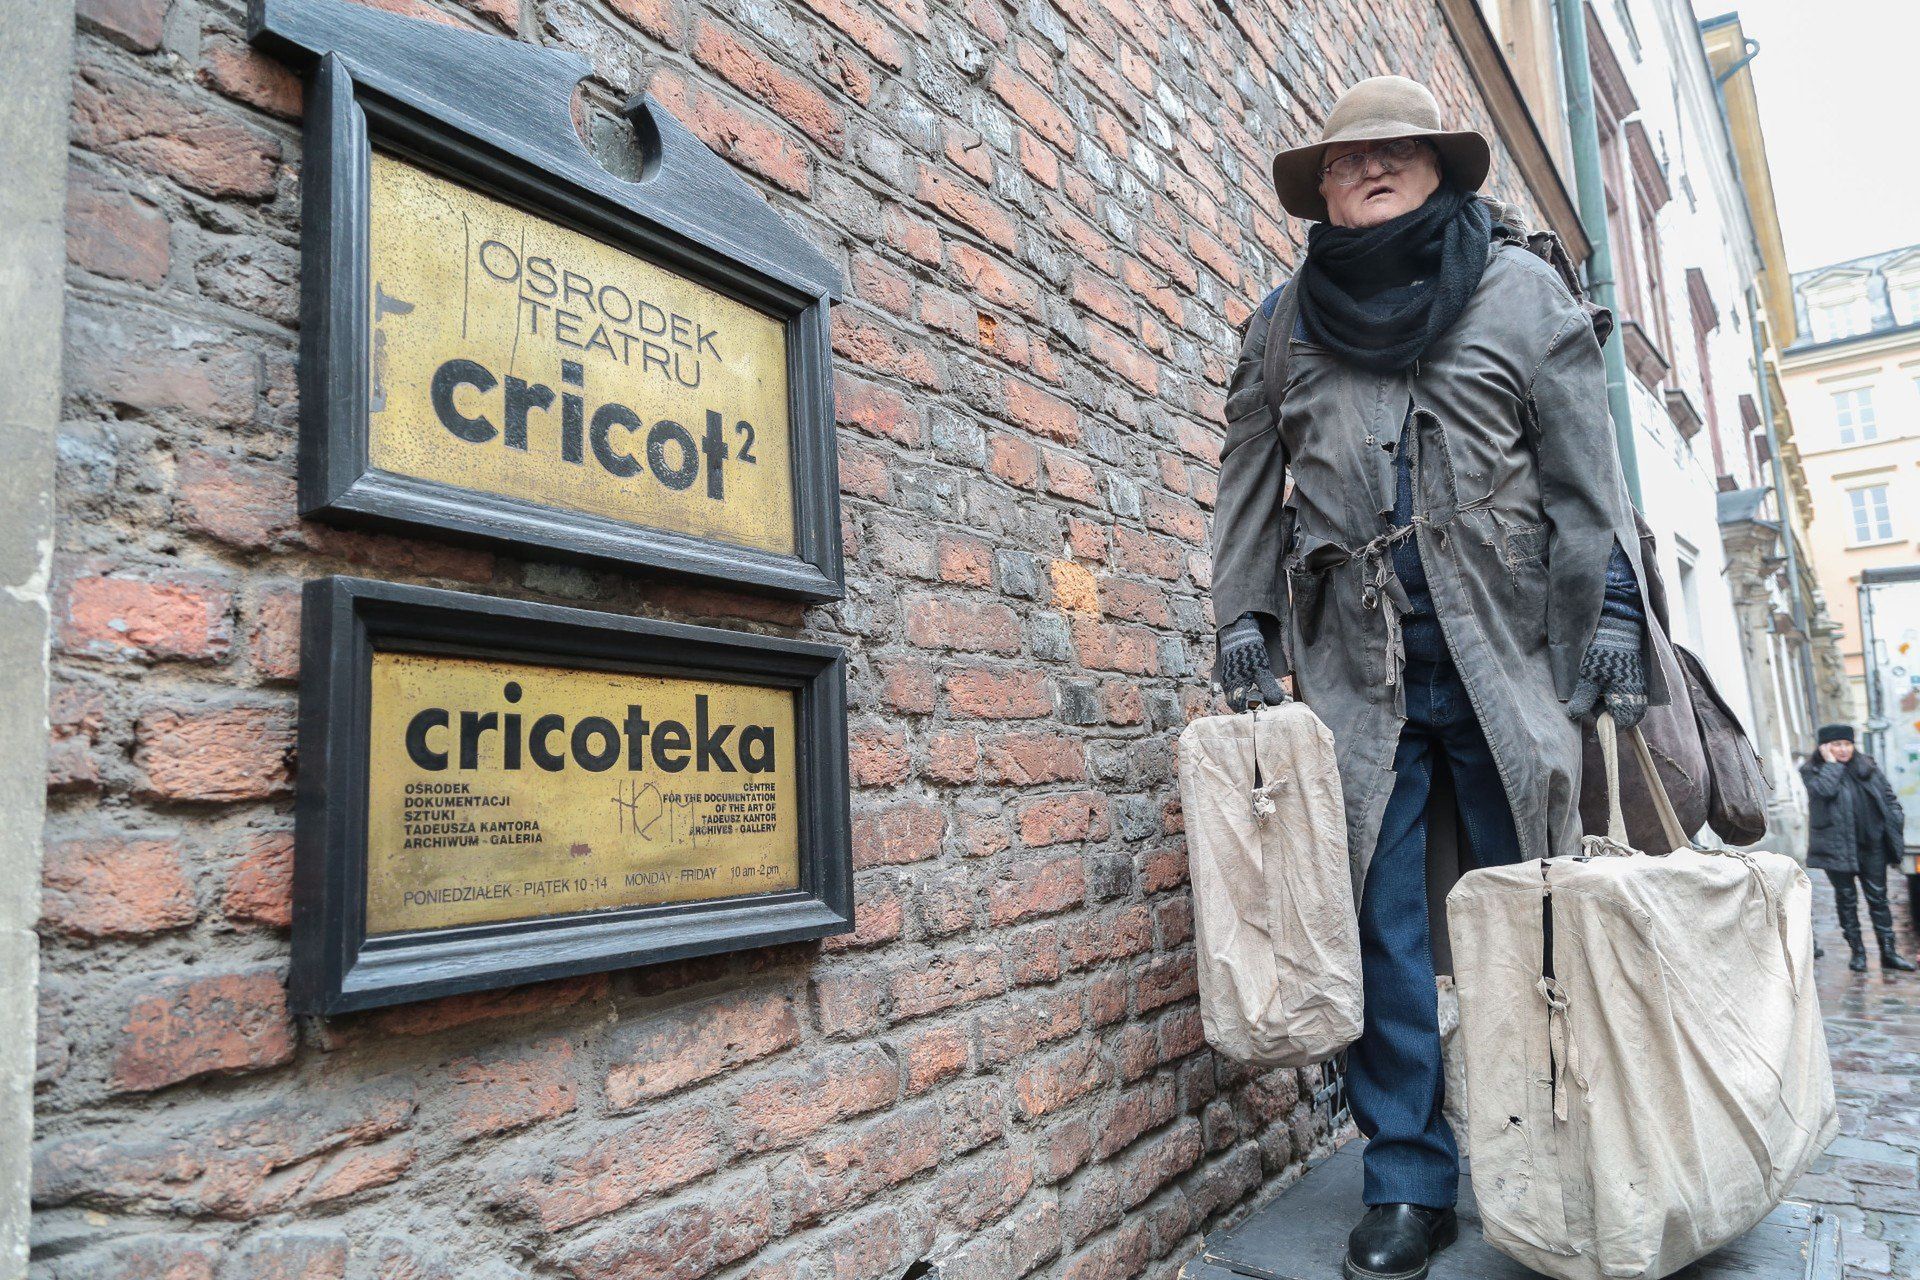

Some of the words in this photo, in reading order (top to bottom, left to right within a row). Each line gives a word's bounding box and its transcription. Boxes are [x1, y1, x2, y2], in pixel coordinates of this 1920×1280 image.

[518, 294, 701, 390] TEATRU
[405, 681, 776, 773] cricoteka
[405, 782, 470, 794] OŚRODEK
[743, 783, 776, 791] CENTRE
[404, 796, 510, 808] DOKUMENTACJI
[663, 794, 681, 803] FOR
[684, 794, 702, 803] THE
[704, 793, 776, 802] DOCUMENTATION
[715, 804, 726, 813] OF
[730, 803, 745, 812] THE
[748, 803, 763, 812] ART
[766, 803, 776, 812] OF
[404, 810, 455, 821] SZTUKI
[702, 815, 741, 824] TADEUSZ
[743, 813, 776, 823] KANTOR
[404, 822, 476, 835] TADEUSZA
[480, 820, 540, 832] KANTORA
[689, 825, 733, 836] ARCHIVES
[740, 823, 777, 834] GALLERY
[404, 836, 479, 849] ARCHIWUM
[490, 833, 543, 845] GALERIA
[625, 872, 673, 887] MONDAY
[680, 867, 717, 883] FRIDAY
[731, 865, 741, 878] 10
[403, 883, 512, 906] PONIEDZIAŁEK
[524, 879, 570, 898] PIĄTEK
[574, 878, 587, 892] 10
